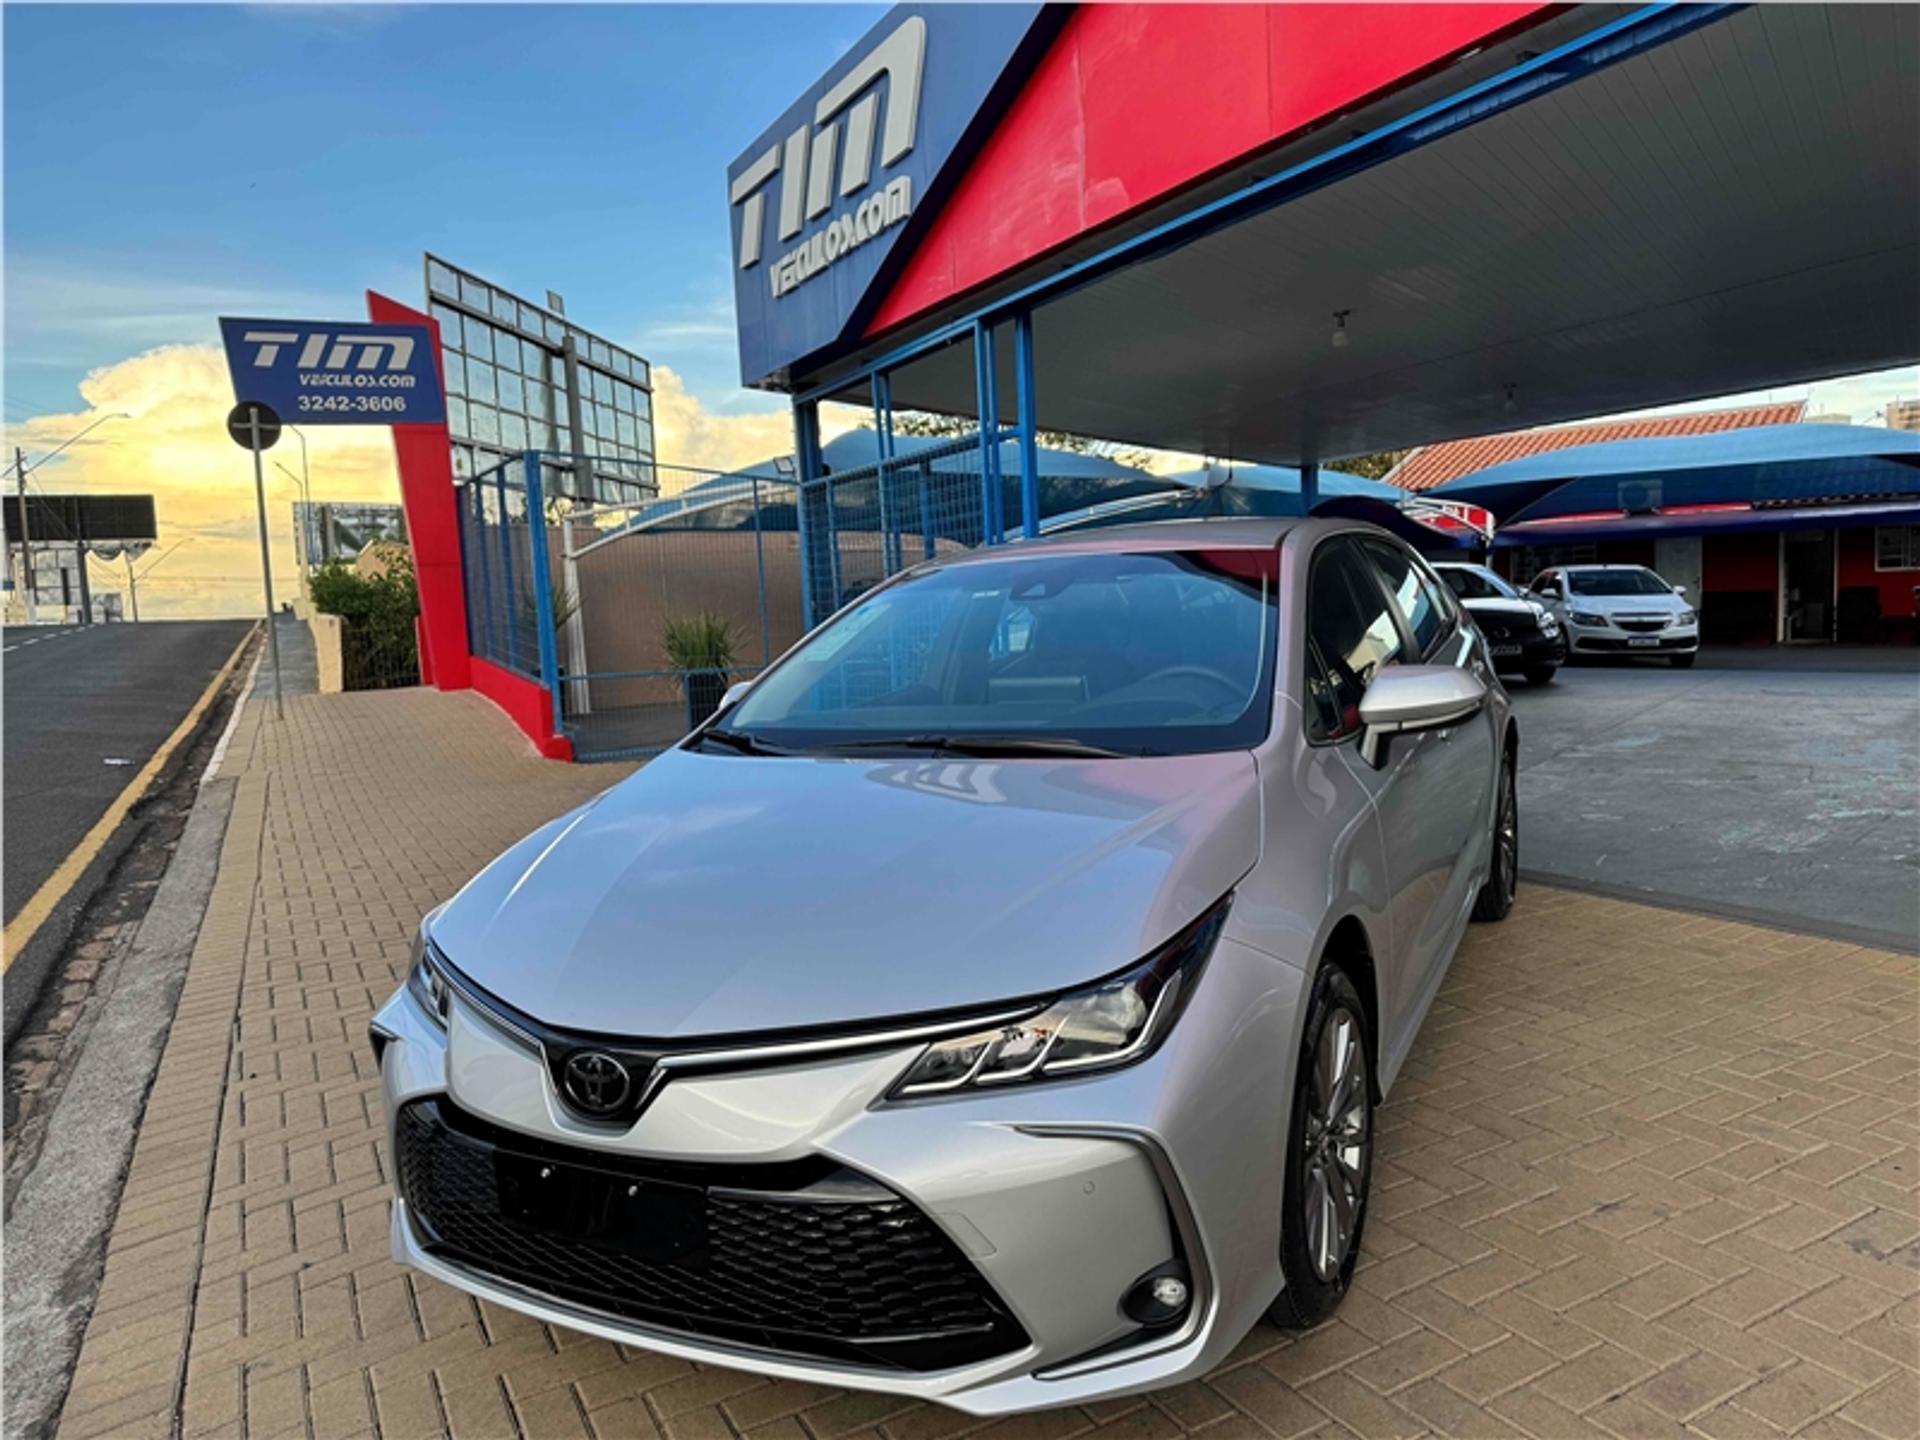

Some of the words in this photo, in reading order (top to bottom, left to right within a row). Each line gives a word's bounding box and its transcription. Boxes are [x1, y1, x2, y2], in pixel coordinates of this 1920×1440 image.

[731, 16, 926, 269] TIM
[244, 331, 415, 370] TIM
[298, 395, 407, 412] 3242-3606
